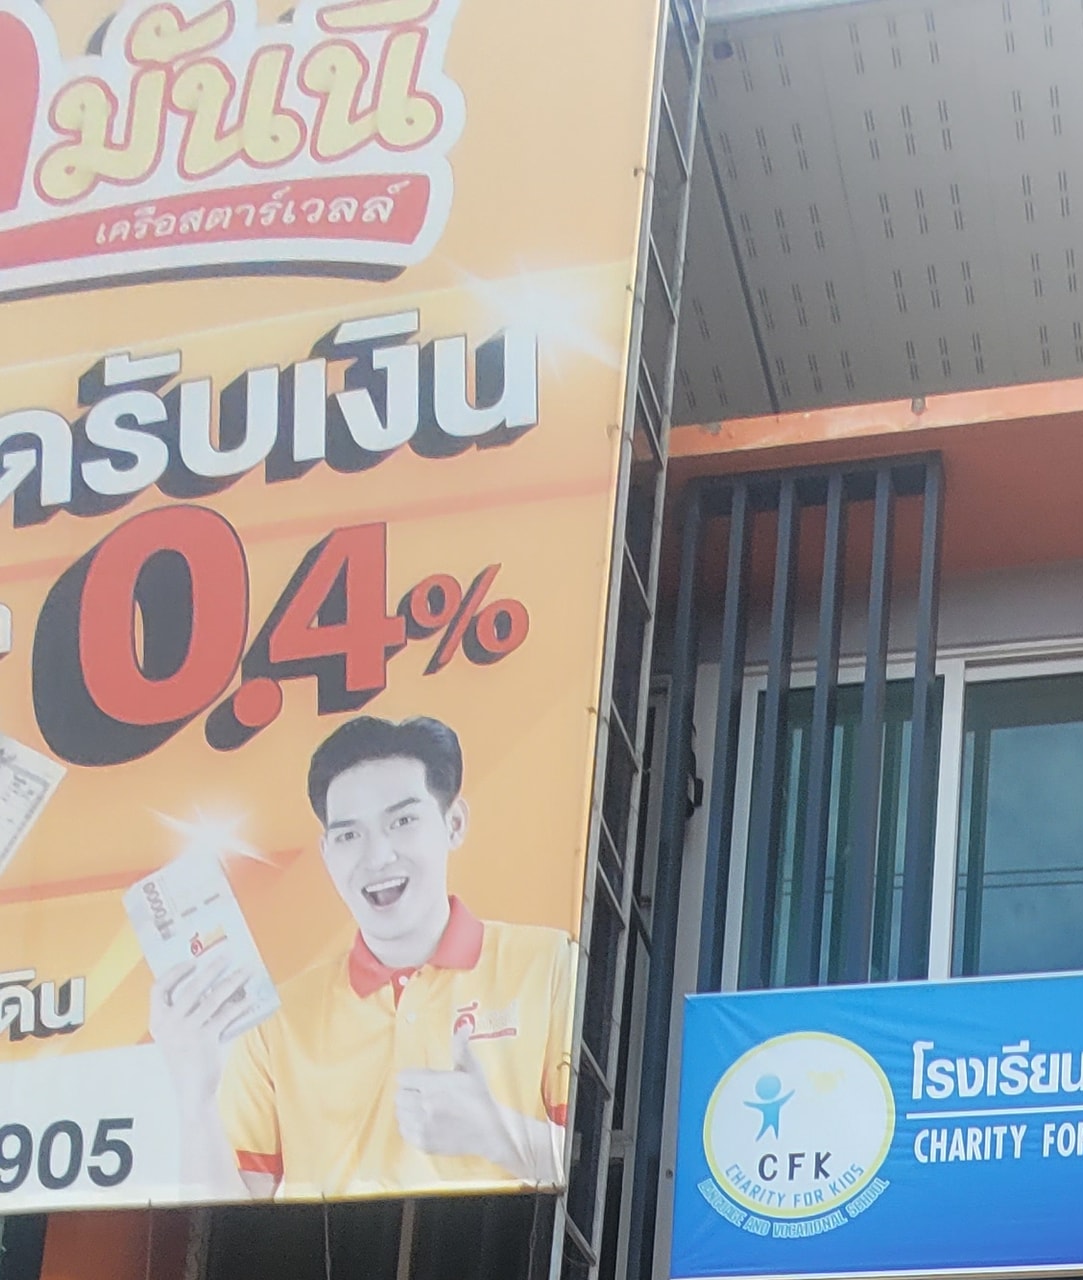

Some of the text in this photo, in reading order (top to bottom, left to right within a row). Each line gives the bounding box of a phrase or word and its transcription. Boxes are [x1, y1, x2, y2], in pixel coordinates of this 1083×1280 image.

[96, 180, 410, 245] เครือสตาร์เวลล์
[79, 504, 530, 727] 0.4%
[0, 1117, 134, 1193] 905
[758, 1151, 832, 1182] CFK
[913, 1124, 1028, 1164] CHARITY
[697, 1176, 891, 1239] LANGUAGE AND VOCATIONAL SCHOOL
[725, 1163, 865, 1209] CHARITY FOR KIDS
